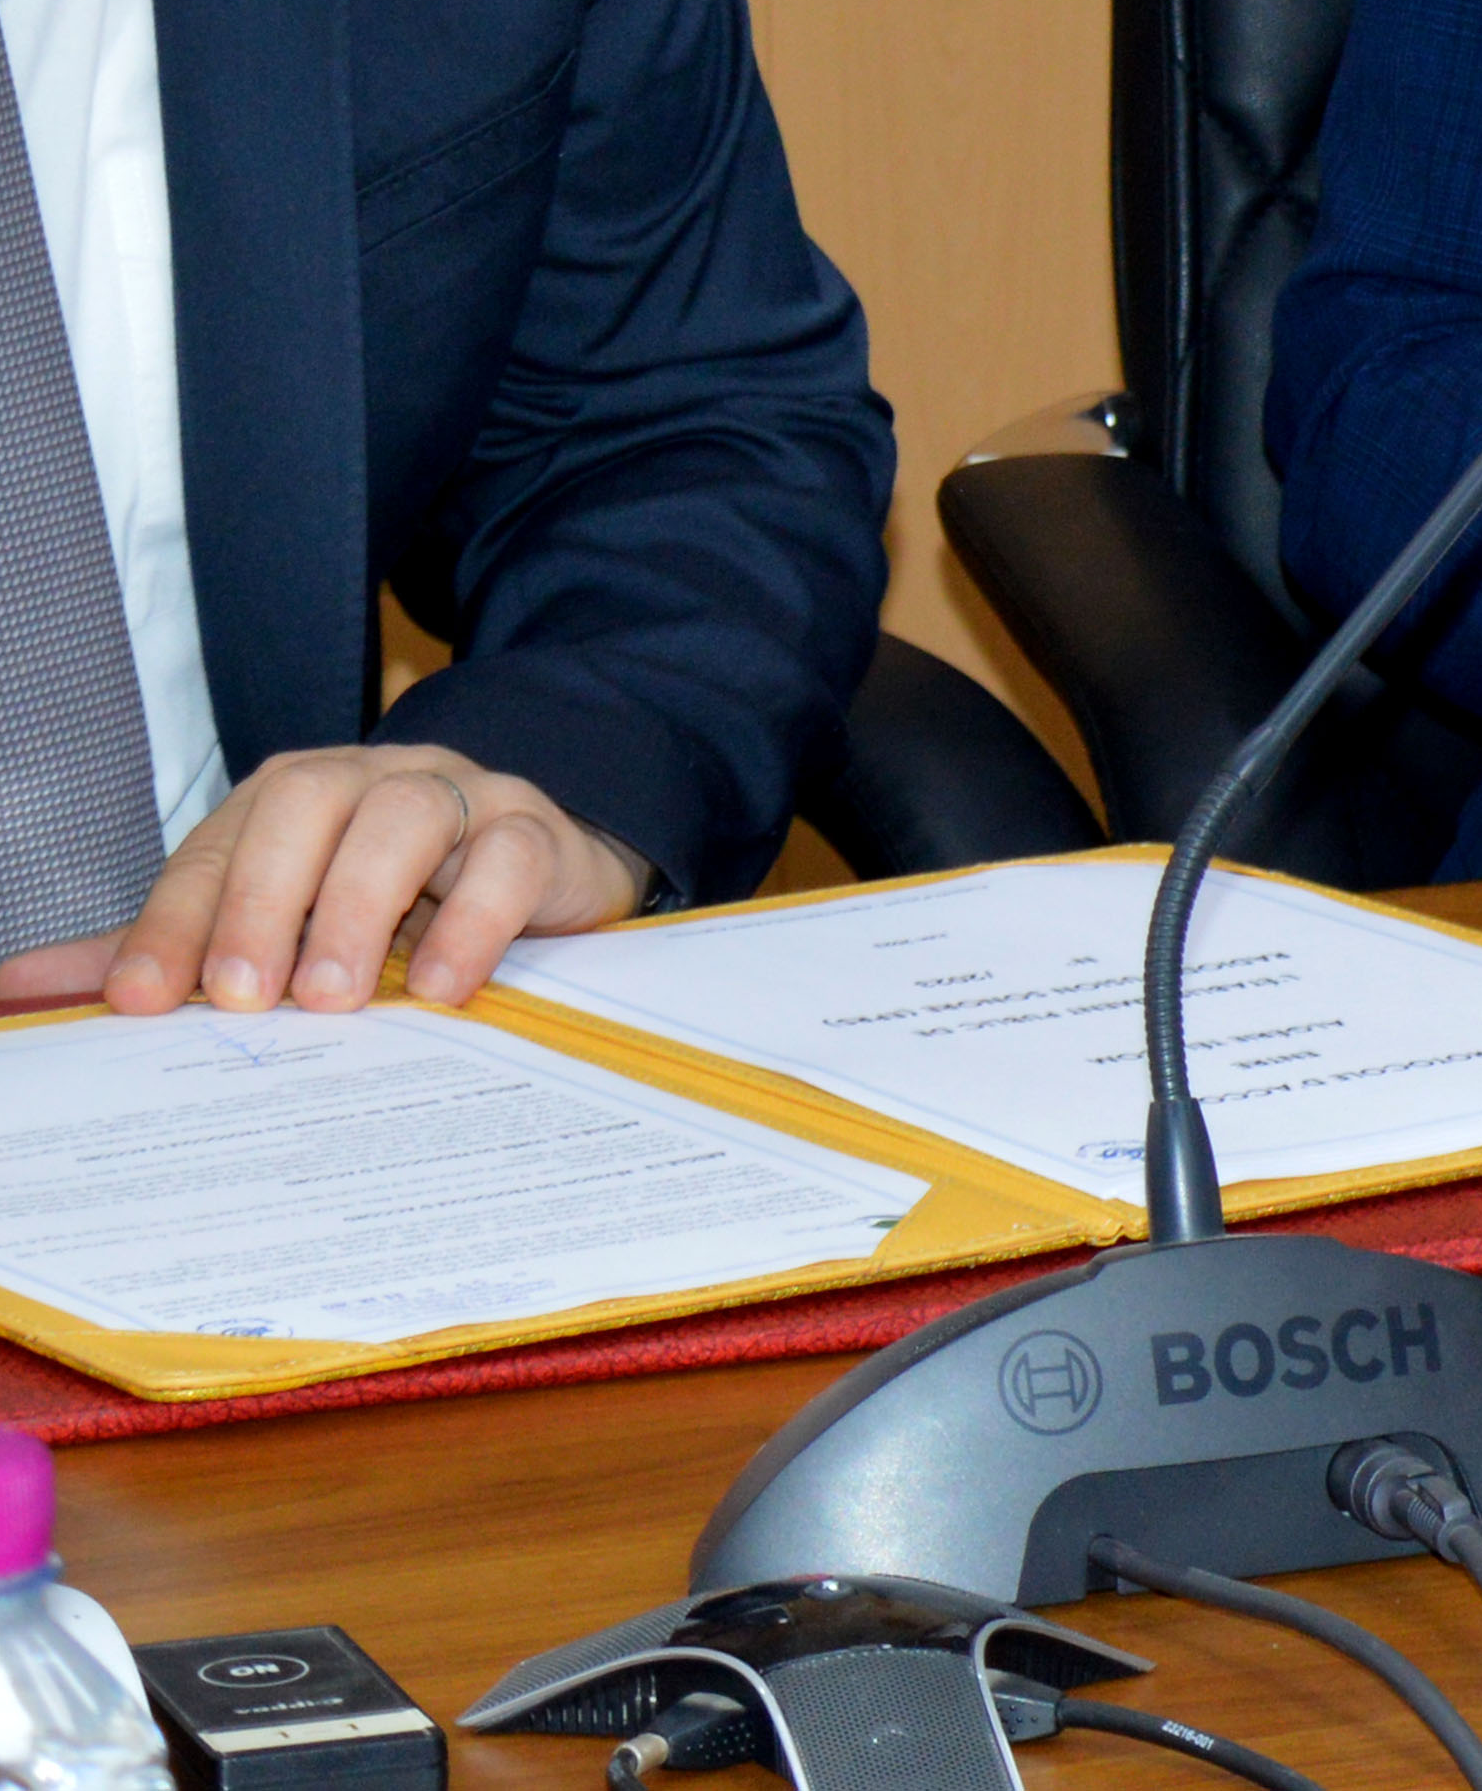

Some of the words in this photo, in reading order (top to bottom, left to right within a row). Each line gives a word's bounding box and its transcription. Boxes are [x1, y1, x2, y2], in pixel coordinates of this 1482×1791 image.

[1195, 1084, 1293, 1104] ACCO
[1150, 1302, 1442, 1406] BOSCH
[229, 1662, 281, 1678] ON
